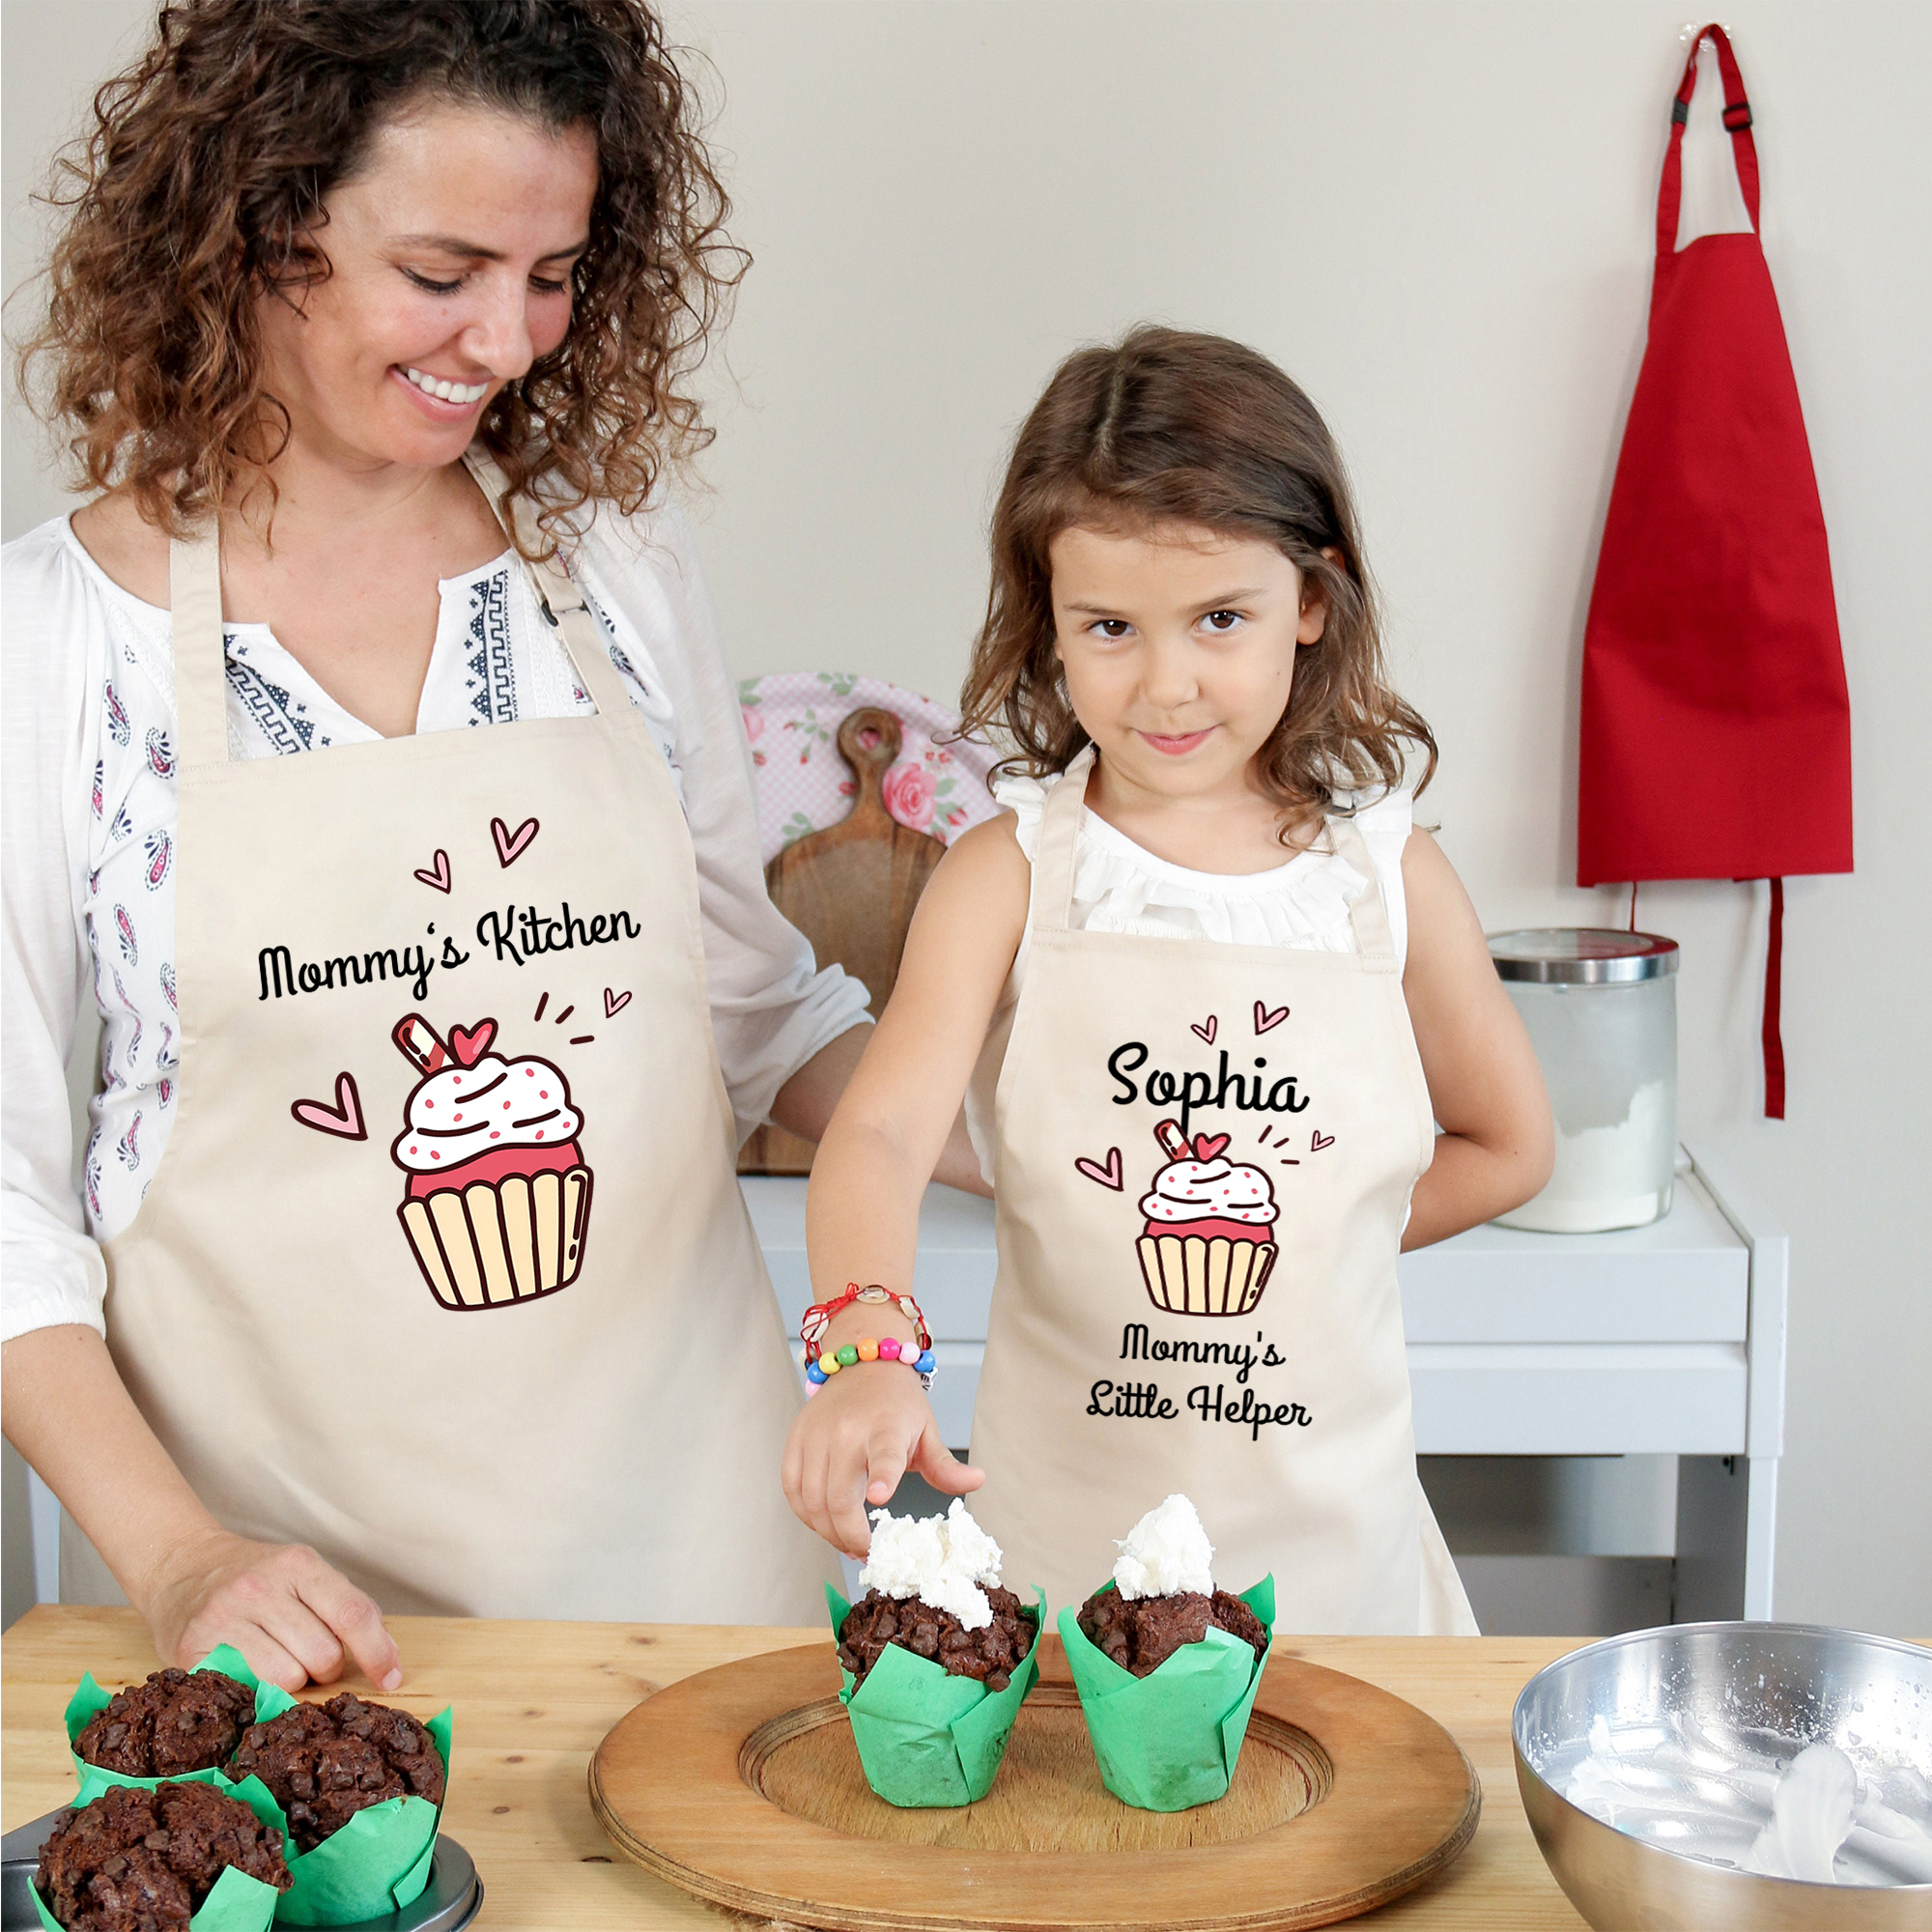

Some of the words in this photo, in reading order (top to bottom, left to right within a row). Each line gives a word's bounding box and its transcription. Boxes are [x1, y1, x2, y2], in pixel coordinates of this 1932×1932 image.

[258, 922, 470, 1002] Mommy's
[476, 901, 641, 967] Kitchen
[1107, 1041, 1310, 1136] Sophia
[1119, 1322, 1287, 1384] Mommy's
[1086, 1379, 1179, 1421] Little
[1186, 1383, 1313, 1442] Helper
